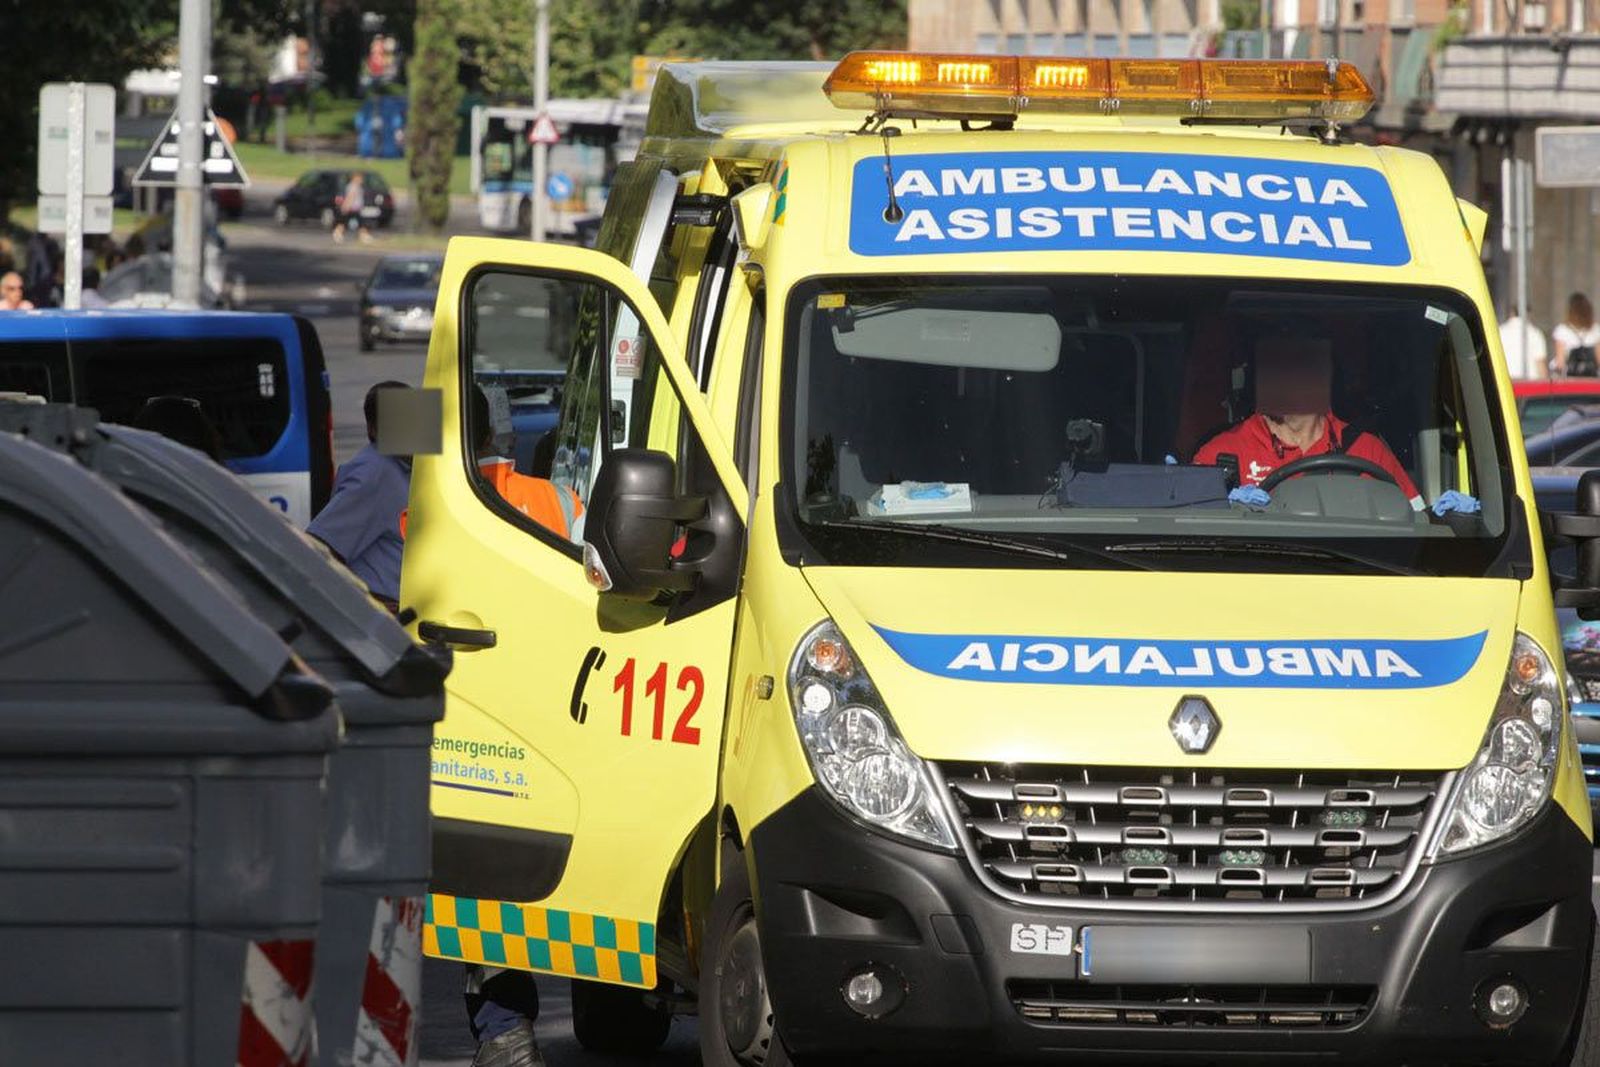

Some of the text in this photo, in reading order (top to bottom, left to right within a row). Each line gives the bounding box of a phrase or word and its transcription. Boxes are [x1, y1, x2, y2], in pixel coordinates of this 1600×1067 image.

[894, 166, 1369, 208] AMBULANCIA
[894, 207, 1373, 251] ASISTENCIAL
[613, 657, 705, 746] 112
[432, 736, 526, 761] emergencias
[430, 758, 528, 786] anitarias, s.a.
[1016, 926, 1067, 951] SP
